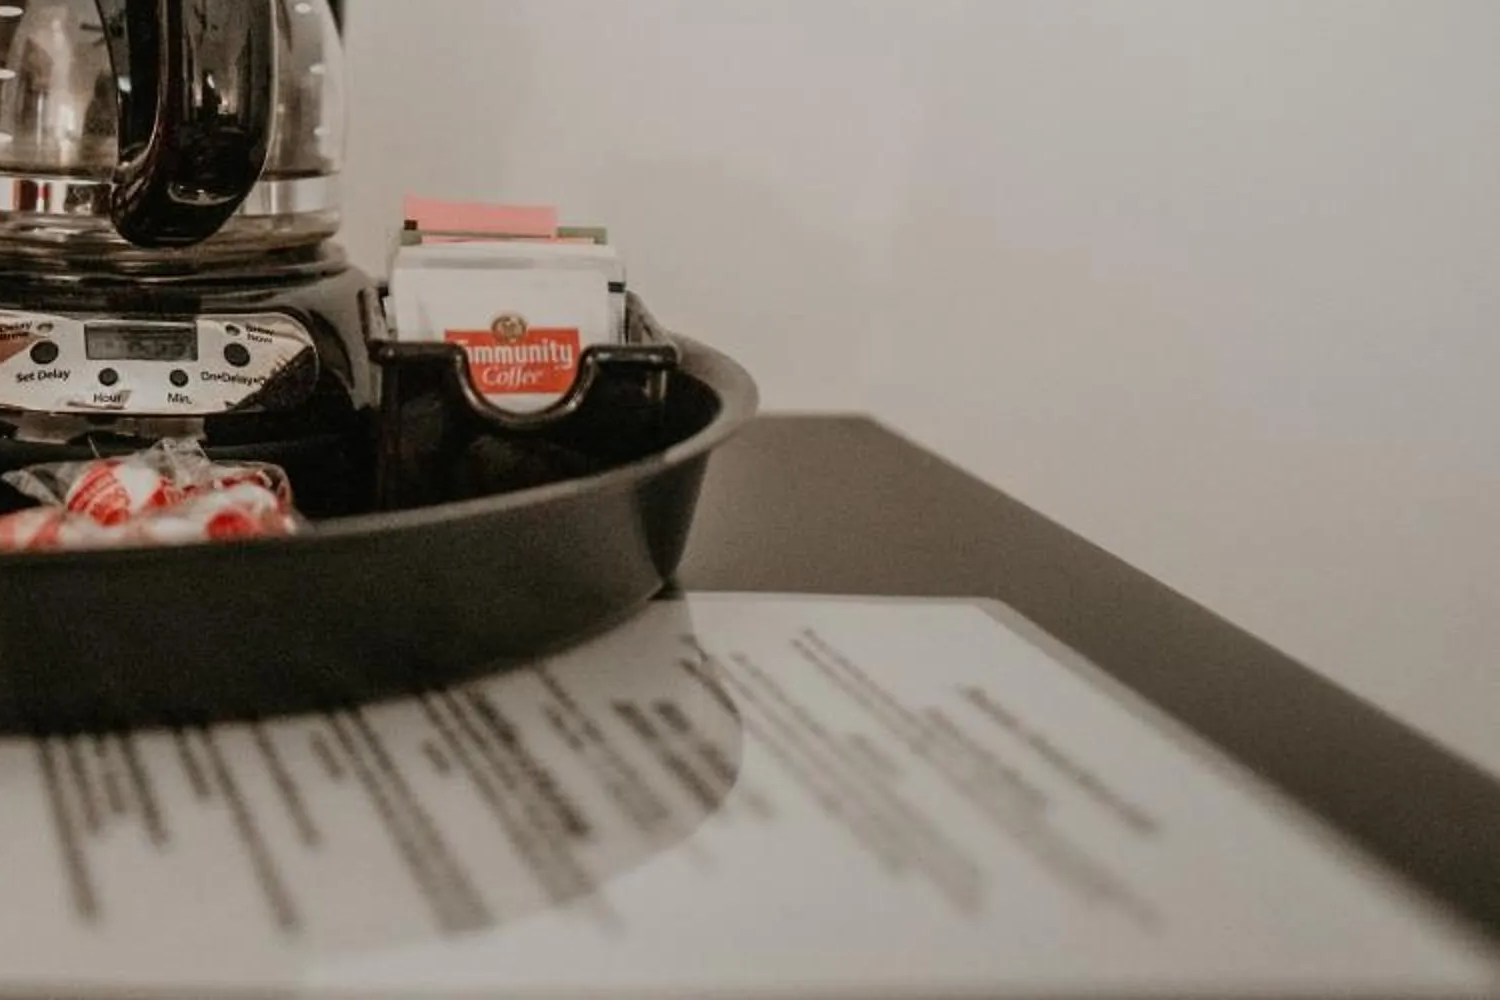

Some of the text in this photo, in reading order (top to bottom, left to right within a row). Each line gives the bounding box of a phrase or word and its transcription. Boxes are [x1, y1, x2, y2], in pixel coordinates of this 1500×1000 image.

[467, 338, 573, 370] mmunity
[16, 368, 71, 383] Set Delay
[93, 392, 122, 403] Hour
[167, 392, 193, 404] Min.
